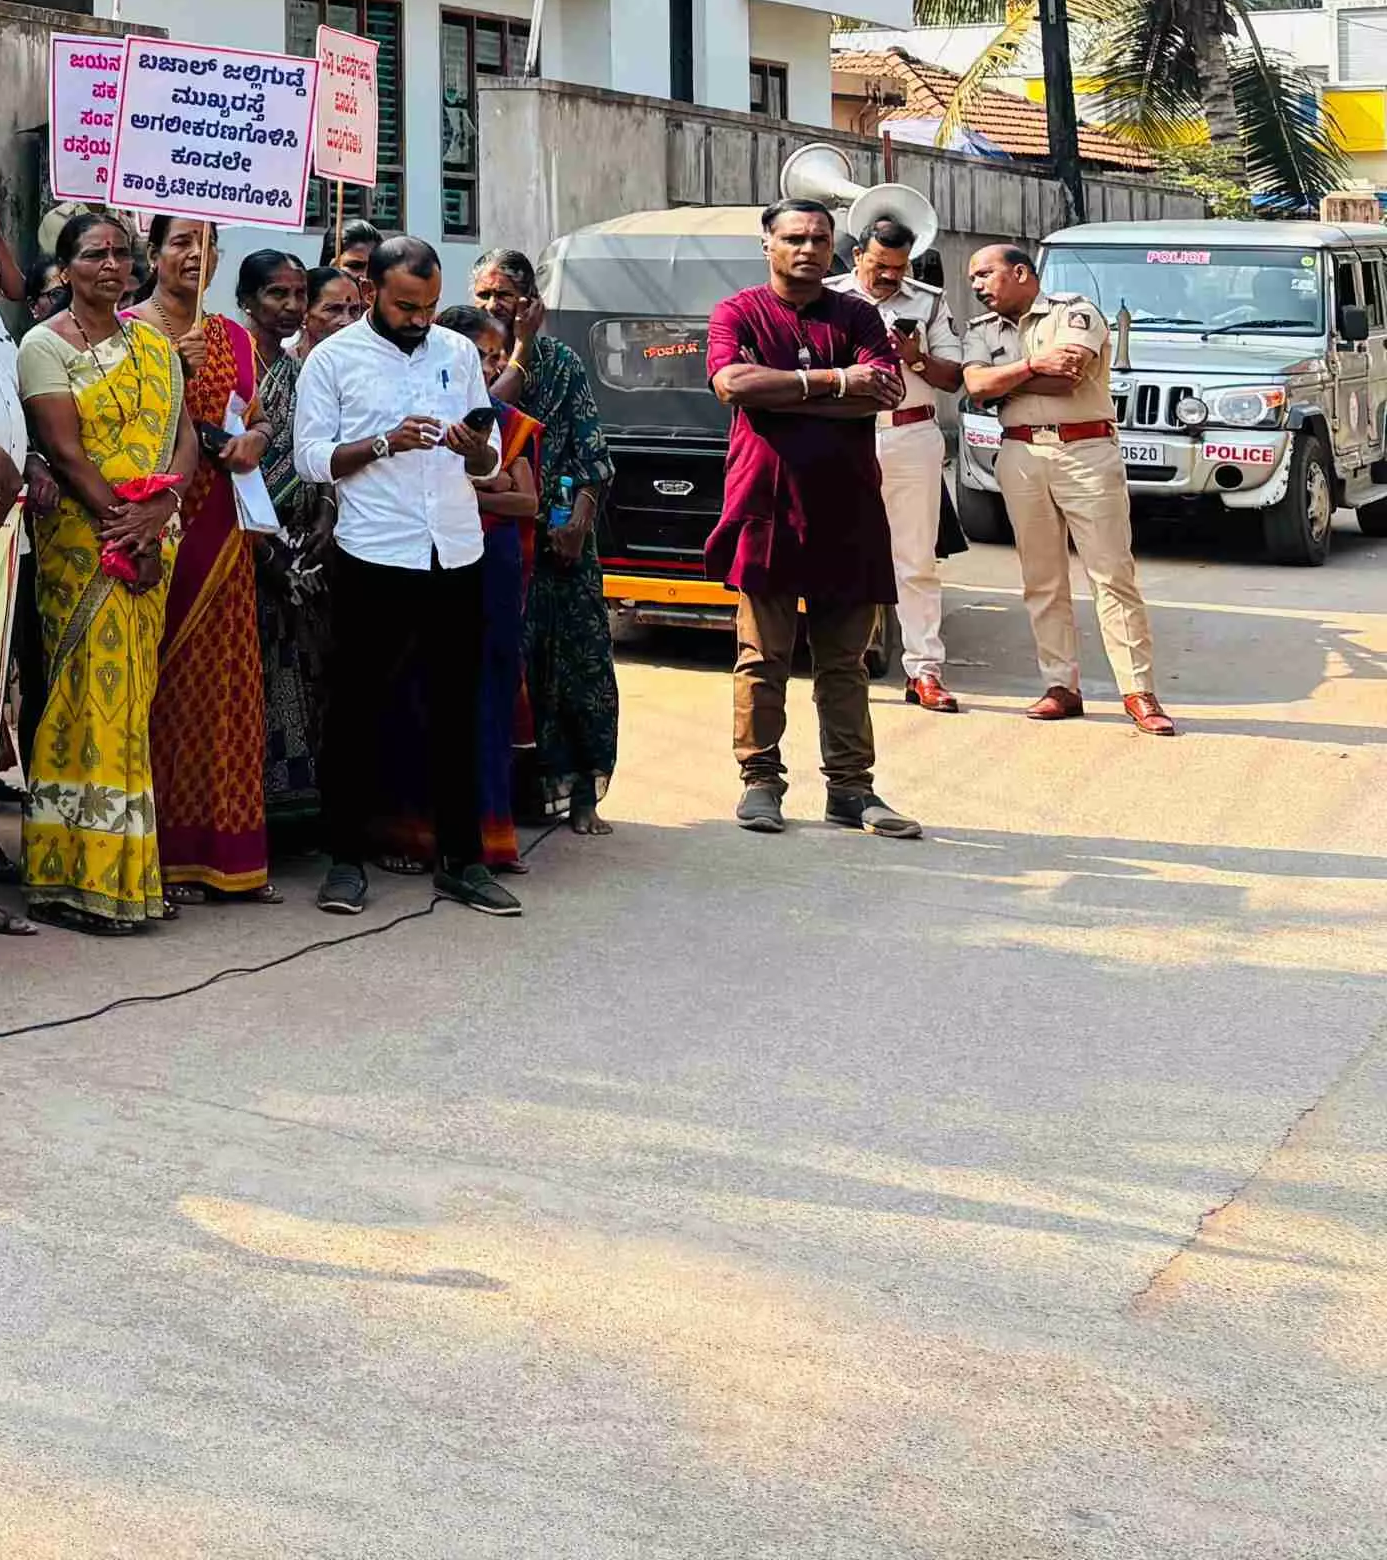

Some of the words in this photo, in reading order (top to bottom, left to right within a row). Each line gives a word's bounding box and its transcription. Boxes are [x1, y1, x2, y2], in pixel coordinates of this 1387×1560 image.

[70, 52, 121, 72] ಜಯನ
[139, 53, 217, 76] ಬಜಾಲ್
[223, 61, 307, 97] ಜಲ್ಲಿಗುಡ್ಡೆ
[171, 85, 265, 121] ಮುಖ್ಯರಸ್ತೆ
[130, 112, 298, 149] ಅಗಲೀಕರಣಗೊಳಿಸಿ
[63, 135, 111, 160] ರಸ್ತೆಯ
[170, 146, 252, 173] ಕೂಡಲೇ
[1147, 251, 1211, 264] POLICE
[1205, 444, 1273, 463] POLICE
